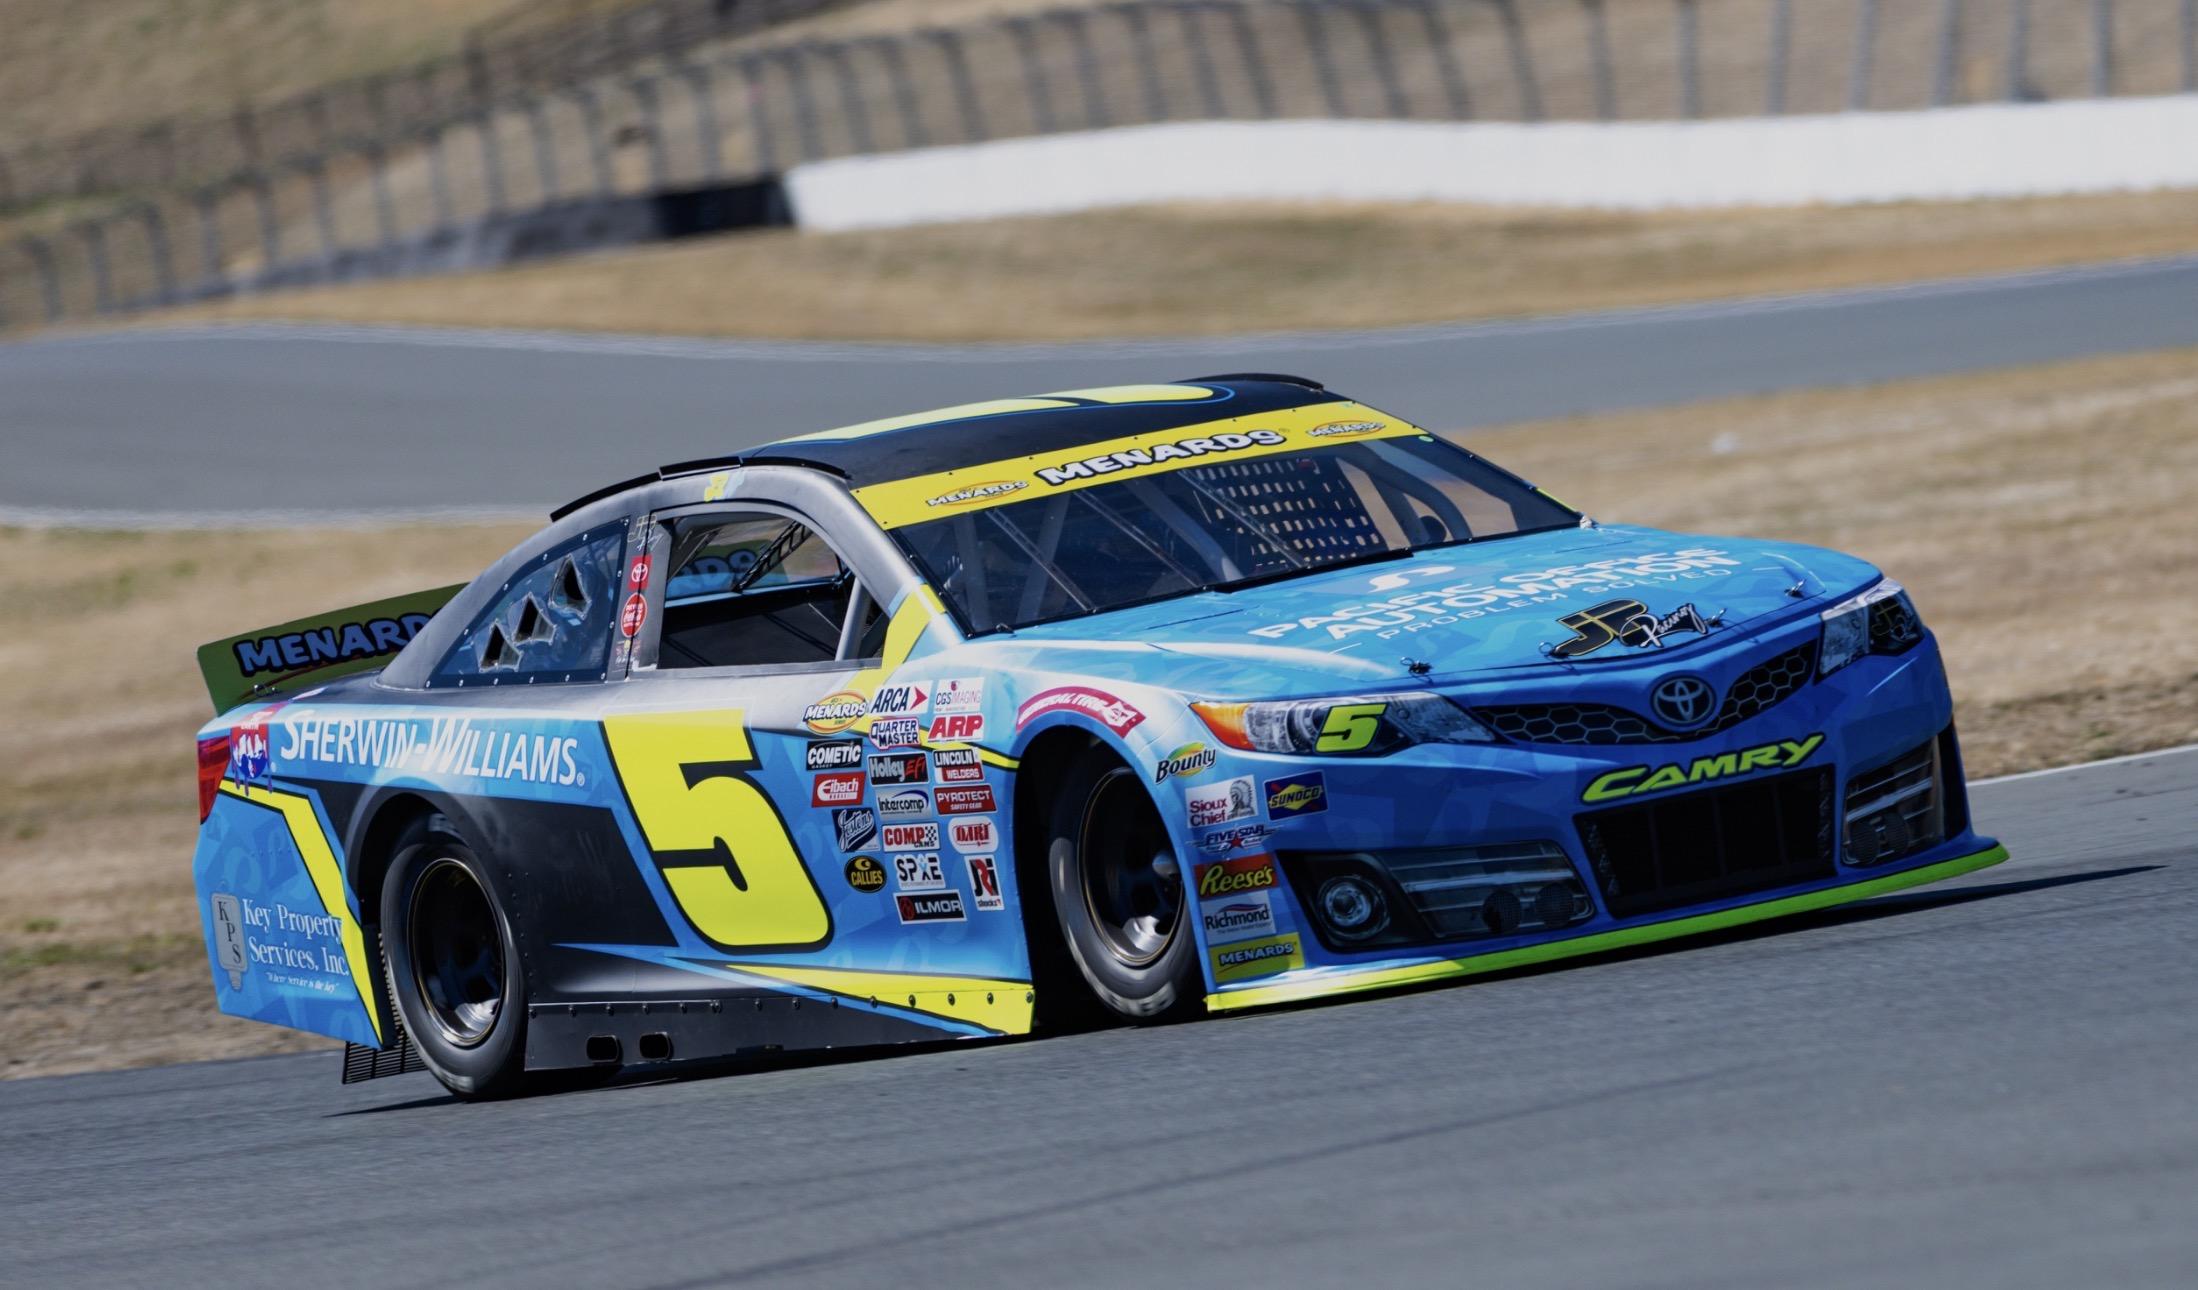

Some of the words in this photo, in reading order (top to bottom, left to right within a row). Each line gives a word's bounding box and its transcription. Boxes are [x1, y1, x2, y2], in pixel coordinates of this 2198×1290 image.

[1034, 429, 1287, 486] MENARDS
[1247, 583, 1495, 639] PACIFIC
[1500, 548, 1729, 583] OFFICE
[1326, 556, 1742, 640] AUTOMATION
[1376, 592, 1569, 640] PROBLEM
[1582, 568, 1732, 593] SOLVED
[233, 610, 443, 677] MENARD
[871, 687, 911, 713] ARCA
[935, 692, 952, 706] CGS
[803, 702, 868, 722] MENARDS
[871, 720, 917, 739] QUARTER
[879, 732, 919, 747] MASTER
[928, 715, 983, 740] ARP
[1314, 704, 1388, 754] 5
[807, 744, 862, 766] COMETIC
[934, 750, 973, 766] LINCOLN
[1155, 748, 1216, 783] Bounty
[870, 757, 905, 781] Holley
[1582, 734, 1825, 802] CAMRY
[816, 777, 860, 802] Eibach
[936, 790, 990, 803] PYROTECT
[1268, 783, 1323, 810] SUNOCO
[1189, 798, 1227, 813] Sioux
[1190, 810, 1226, 827] Chief
[602, 708, 834, 955] 5
[884, 827, 926, 846] COMP
[1204, 831, 1234, 846] FIVE
[1239, 824, 1266, 837] STAR
[850, 869, 884, 886] CALLIES
[1200, 864, 1274, 896] Reese's
[217, 901, 229, 921] K
[915, 900, 962, 914] ILMOR
[1204, 904, 1270, 930] Richmond
[226, 923, 236, 942] P
[242, 898, 271, 933] Key
[276, 904, 343, 946] Property
[232, 945, 242, 964] S
[248, 937, 320, 972] Services,
[321, 946, 350, 976] Inc.
[1219, 943, 1294, 967] MENARDS
